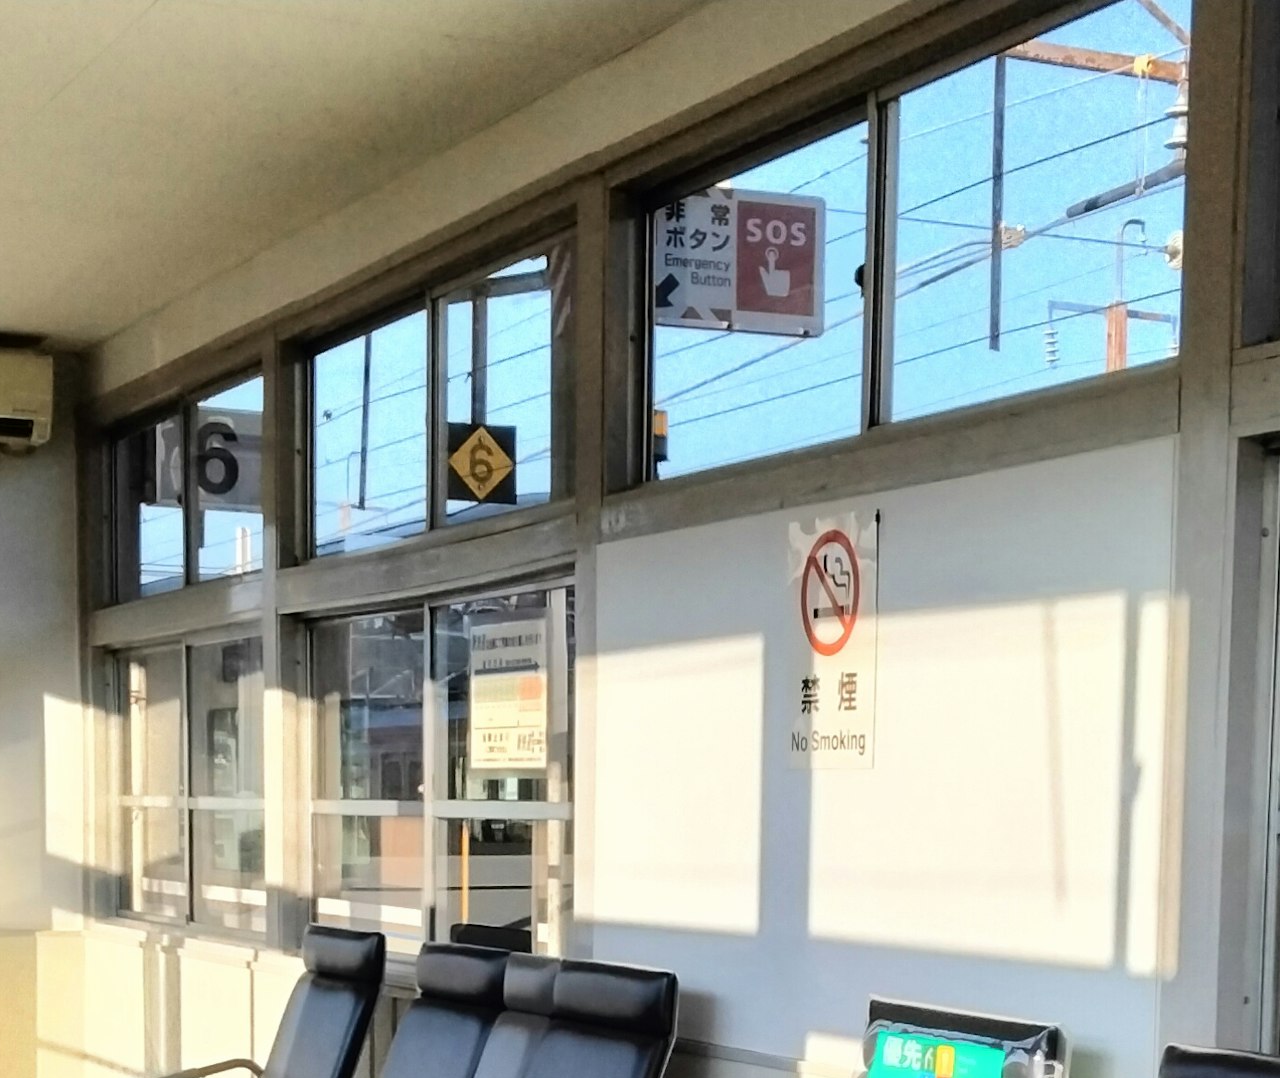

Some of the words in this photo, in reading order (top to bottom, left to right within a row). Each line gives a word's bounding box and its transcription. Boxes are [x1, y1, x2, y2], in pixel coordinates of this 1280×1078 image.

[665, 202, 731, 227] 非常
[666, 227, 731, 252] ボタン
[746, 218, 807, 247] SOS
[664, 253, 731, 271] Emergency
[690, 271, 731, 287] Button
[196, 422, 239, 495] 6
[469, 443, 494, 484] 6
[801, 672, 858, 714] 禁煙
[791, 731, 809, 752] No
[811, 729, 866, 756] Smoking
